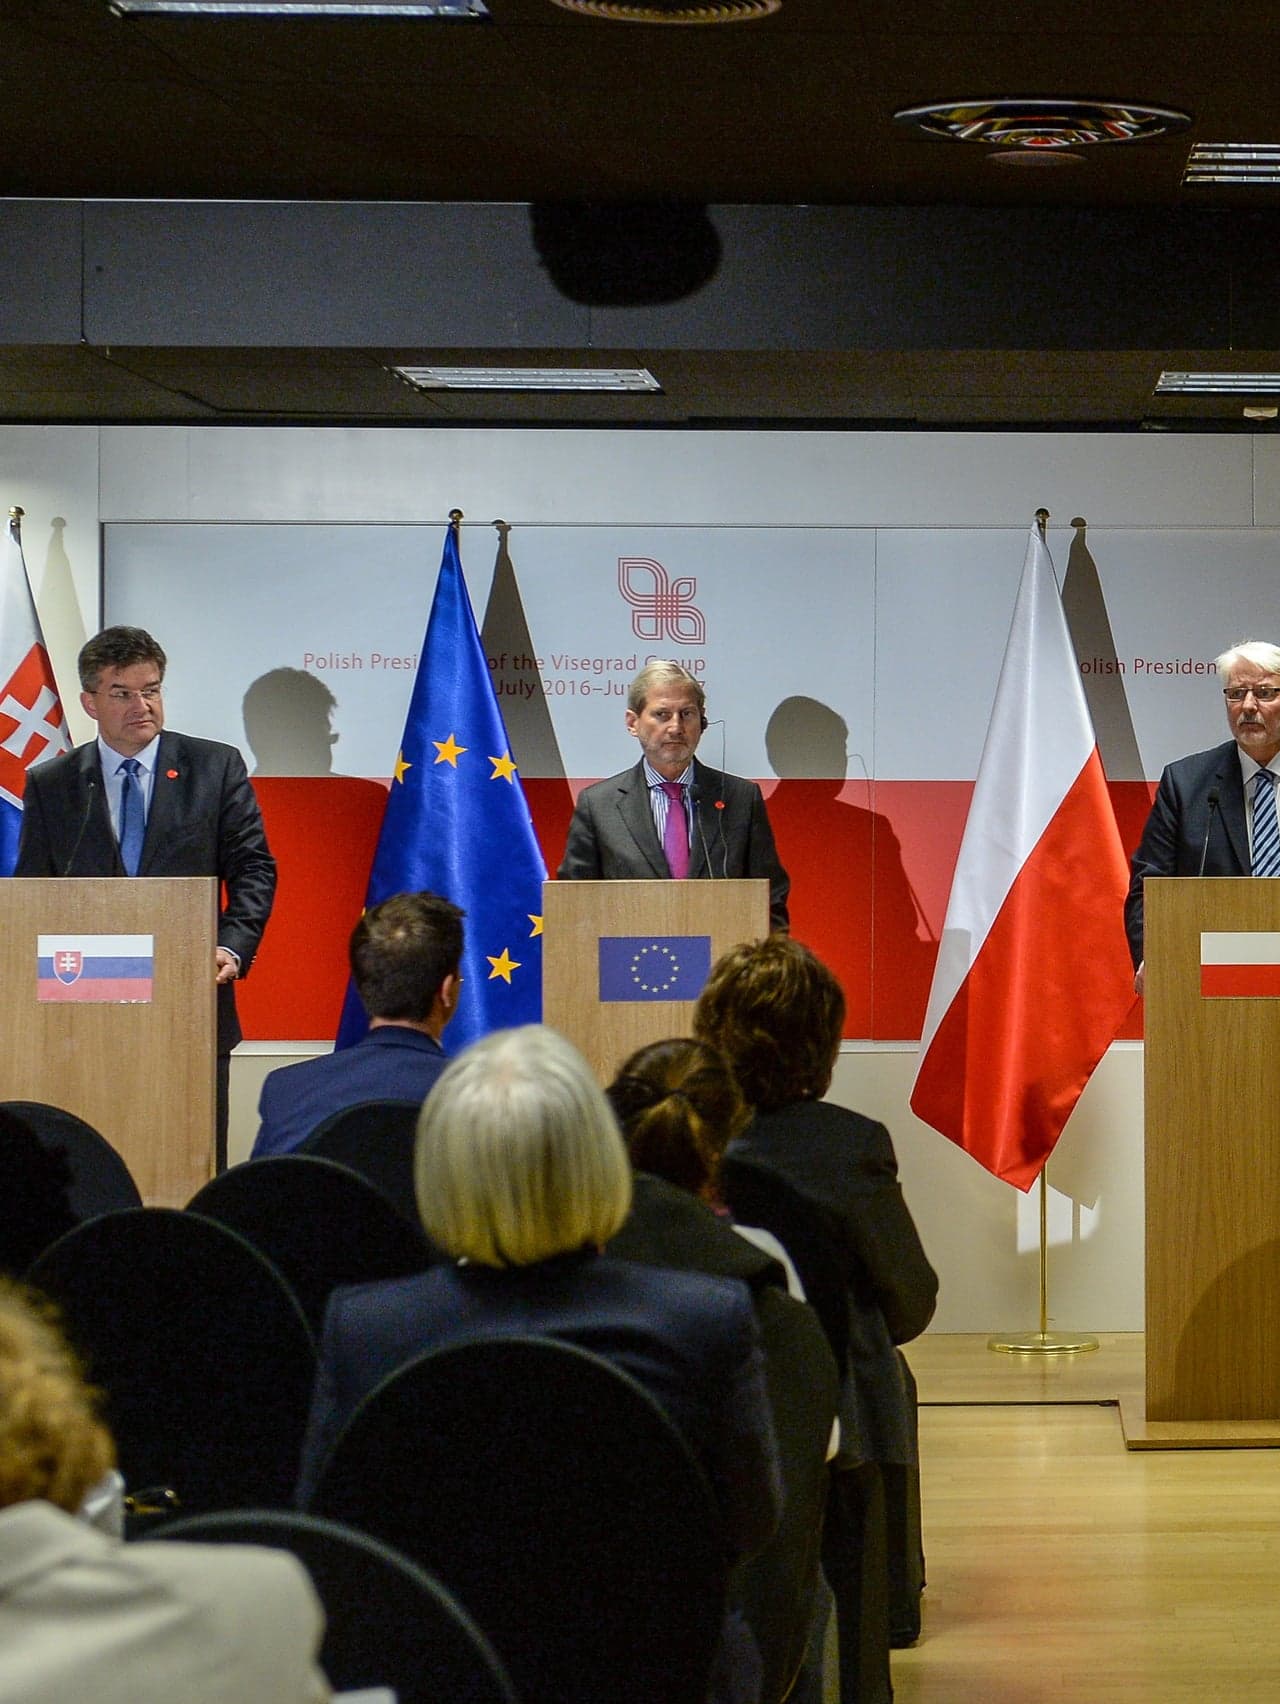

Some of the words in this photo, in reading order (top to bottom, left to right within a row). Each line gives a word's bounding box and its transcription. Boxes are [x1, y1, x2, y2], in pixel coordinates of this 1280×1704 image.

[303, 653, 363, 670] Polish
[371, 654, 417, 670] Presi
[488, 654, 505, 670] of
[513, 654, 545, 671] the
[551, 654, 637, 674] Visegrad
[1080, 658, 1125, 675] olish
[1134, 658, 1217, 675] Presiden
[496, 680, 536, 699] July
[542, 680, 630, 696] 2016–Ju
